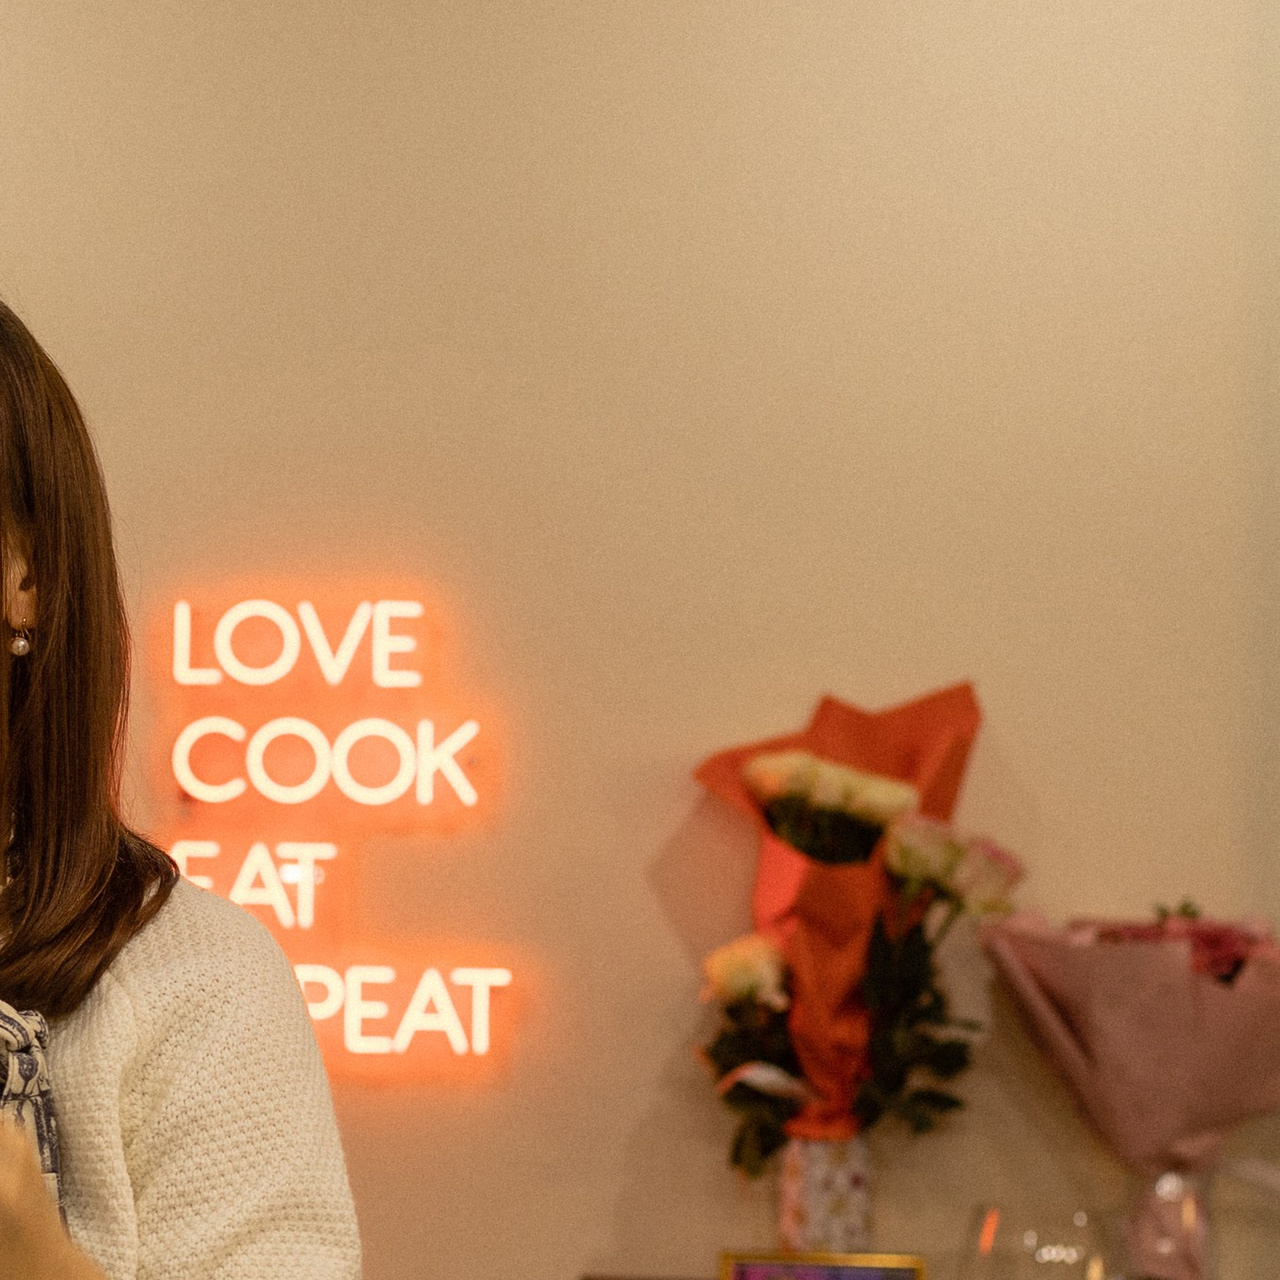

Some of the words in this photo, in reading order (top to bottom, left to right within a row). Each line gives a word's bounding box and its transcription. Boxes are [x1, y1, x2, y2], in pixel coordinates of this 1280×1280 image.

[172, 598, 424, 688] LOVE
[171, 715, 480, 807] COOK
[169, 840, 338, 929] EAT
[293, 963, 512, 1056] PEAT
